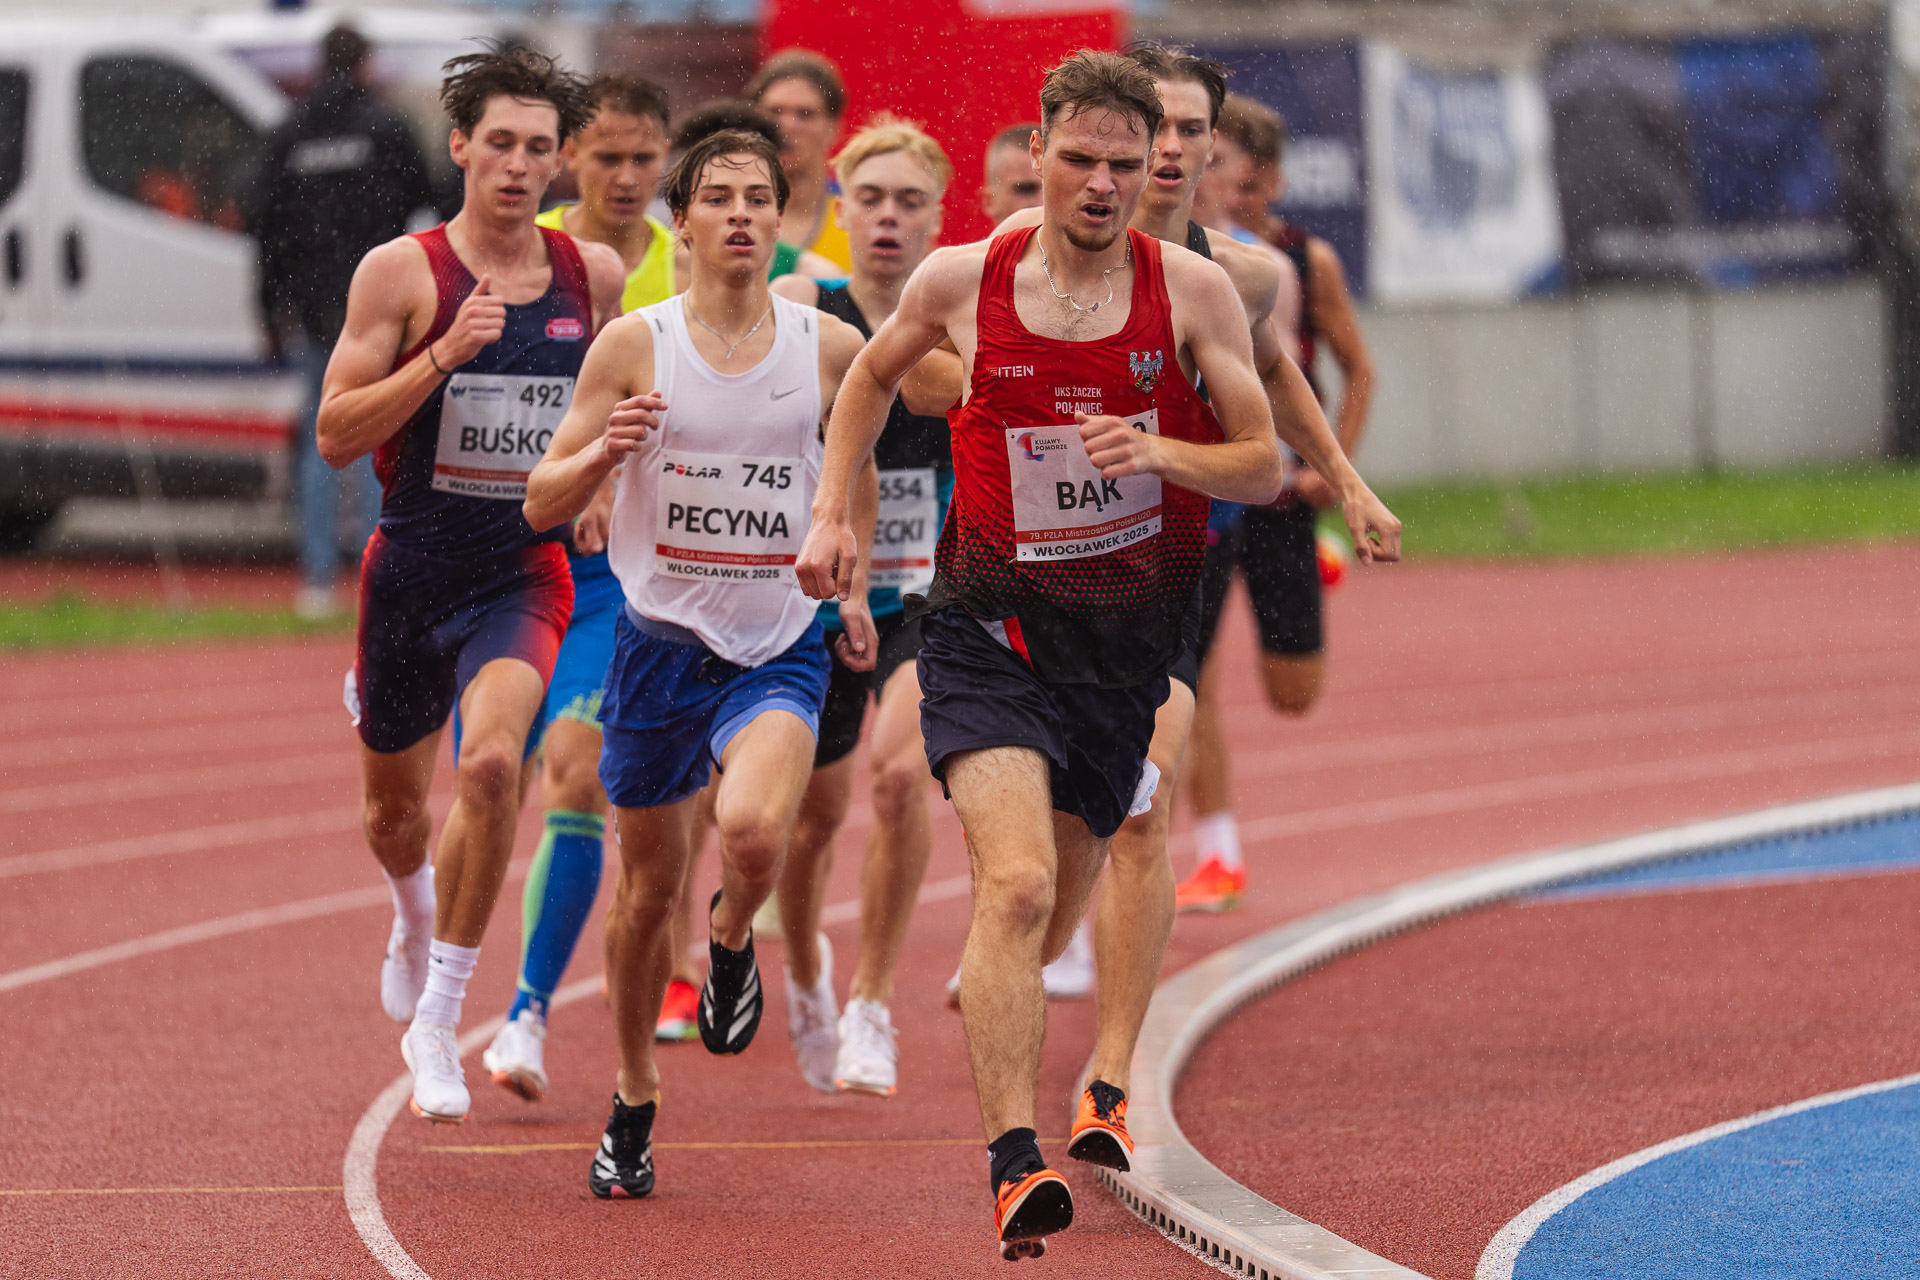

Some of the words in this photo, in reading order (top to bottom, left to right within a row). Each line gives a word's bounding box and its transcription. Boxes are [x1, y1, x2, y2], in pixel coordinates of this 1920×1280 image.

[519, 384, 564, 408] 492
[1054, 386, 1071, 397] UKS
[1072, 385, 1102, 398] ŻACZEK
[1055, 401, 1103, 415] POŁANIEC
[1035, 443, 1068, 451] POMORZE
[663, 462, 722, 479] POLAR
[742, 463, 792, 489] 745
[1056, 477, 1124, 513] BĄK
[668, 502, 789, 539] PECYNA
[1030, 532, 1043, 540] 79.
[1044, 530, 1064, 540] PZLA
[1065, 523, 1114, 538] Mistrzostwa
[1115, 515, 1137, 529] Polski
[1137, 510, 1151, 521] U20
[1033, 536, 1121, 557] WŁOCŁAWEK
[1122, 524, 1149, 543] 2025
[667, 562, 749, 579] WŁOCŁAWEK
[752, 569, 780, 579] 2025
